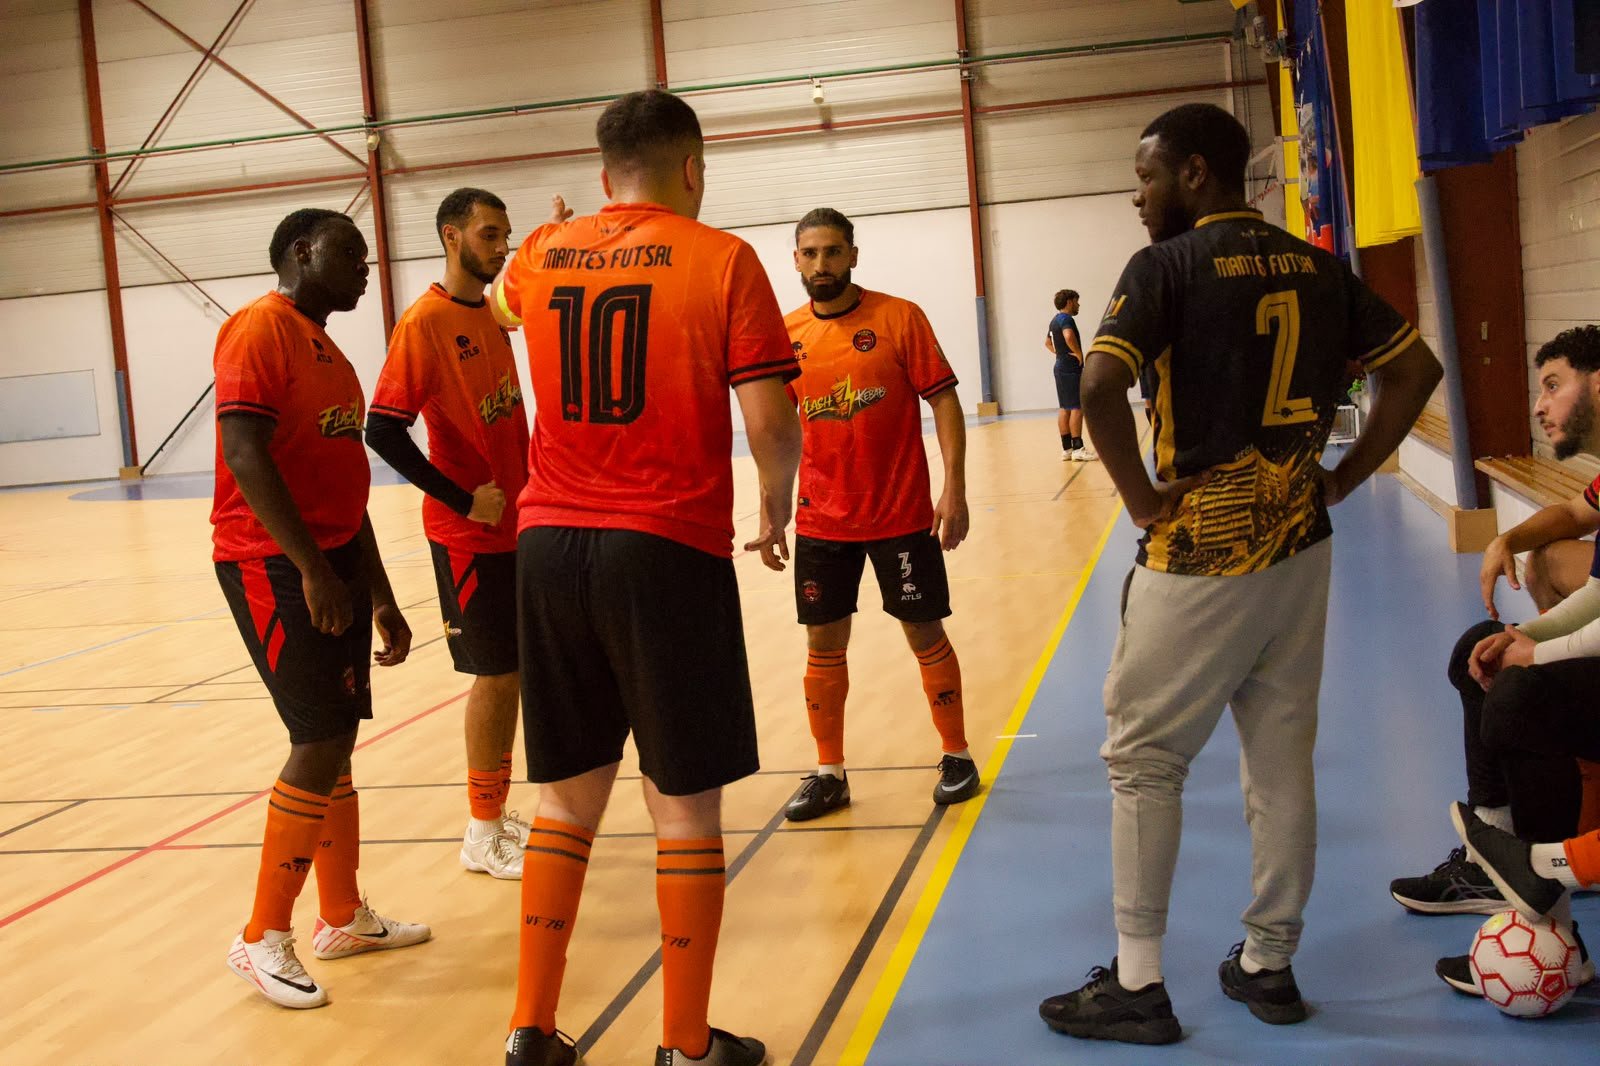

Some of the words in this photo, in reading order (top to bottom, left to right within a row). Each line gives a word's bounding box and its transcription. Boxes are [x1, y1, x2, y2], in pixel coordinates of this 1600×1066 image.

[543, 247, 606, 270] MANTES
[610, 244, 673, 269] FUTSAL
[459, 345, 481, 362] ATLS
[548, 283, 653, 426] 10
[1255, 289, 1319, 427] 2
[855, 385, 887, 408] KEBAB
[897, 551, 912, 579] 3
[900, 592, 922, 601] ATLS
